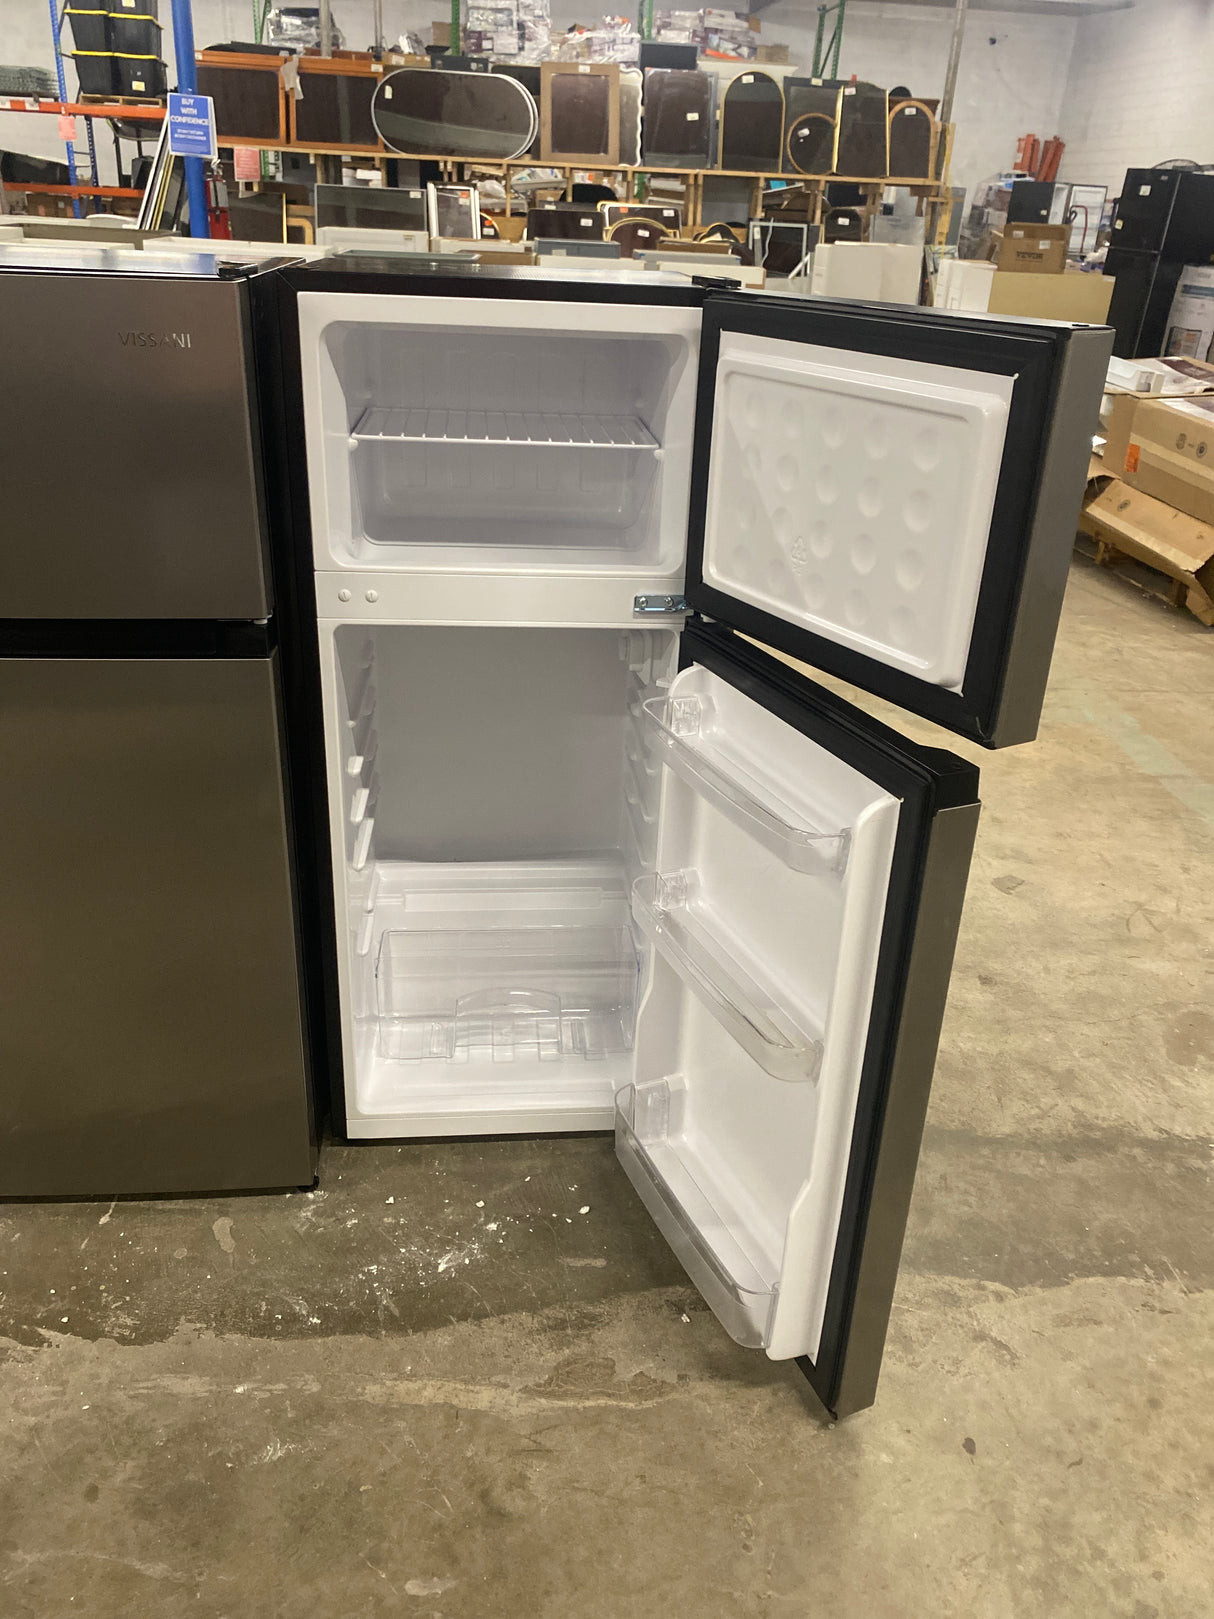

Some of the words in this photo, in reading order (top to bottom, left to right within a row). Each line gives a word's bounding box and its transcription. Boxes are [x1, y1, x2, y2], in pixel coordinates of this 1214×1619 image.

[181, 97, 194, 105] BUY
[180, 107, 198, 115] WITH
[170, 115, 210, 126] CONFIDENCE
[117, 331, 192, 348] VISSANI
